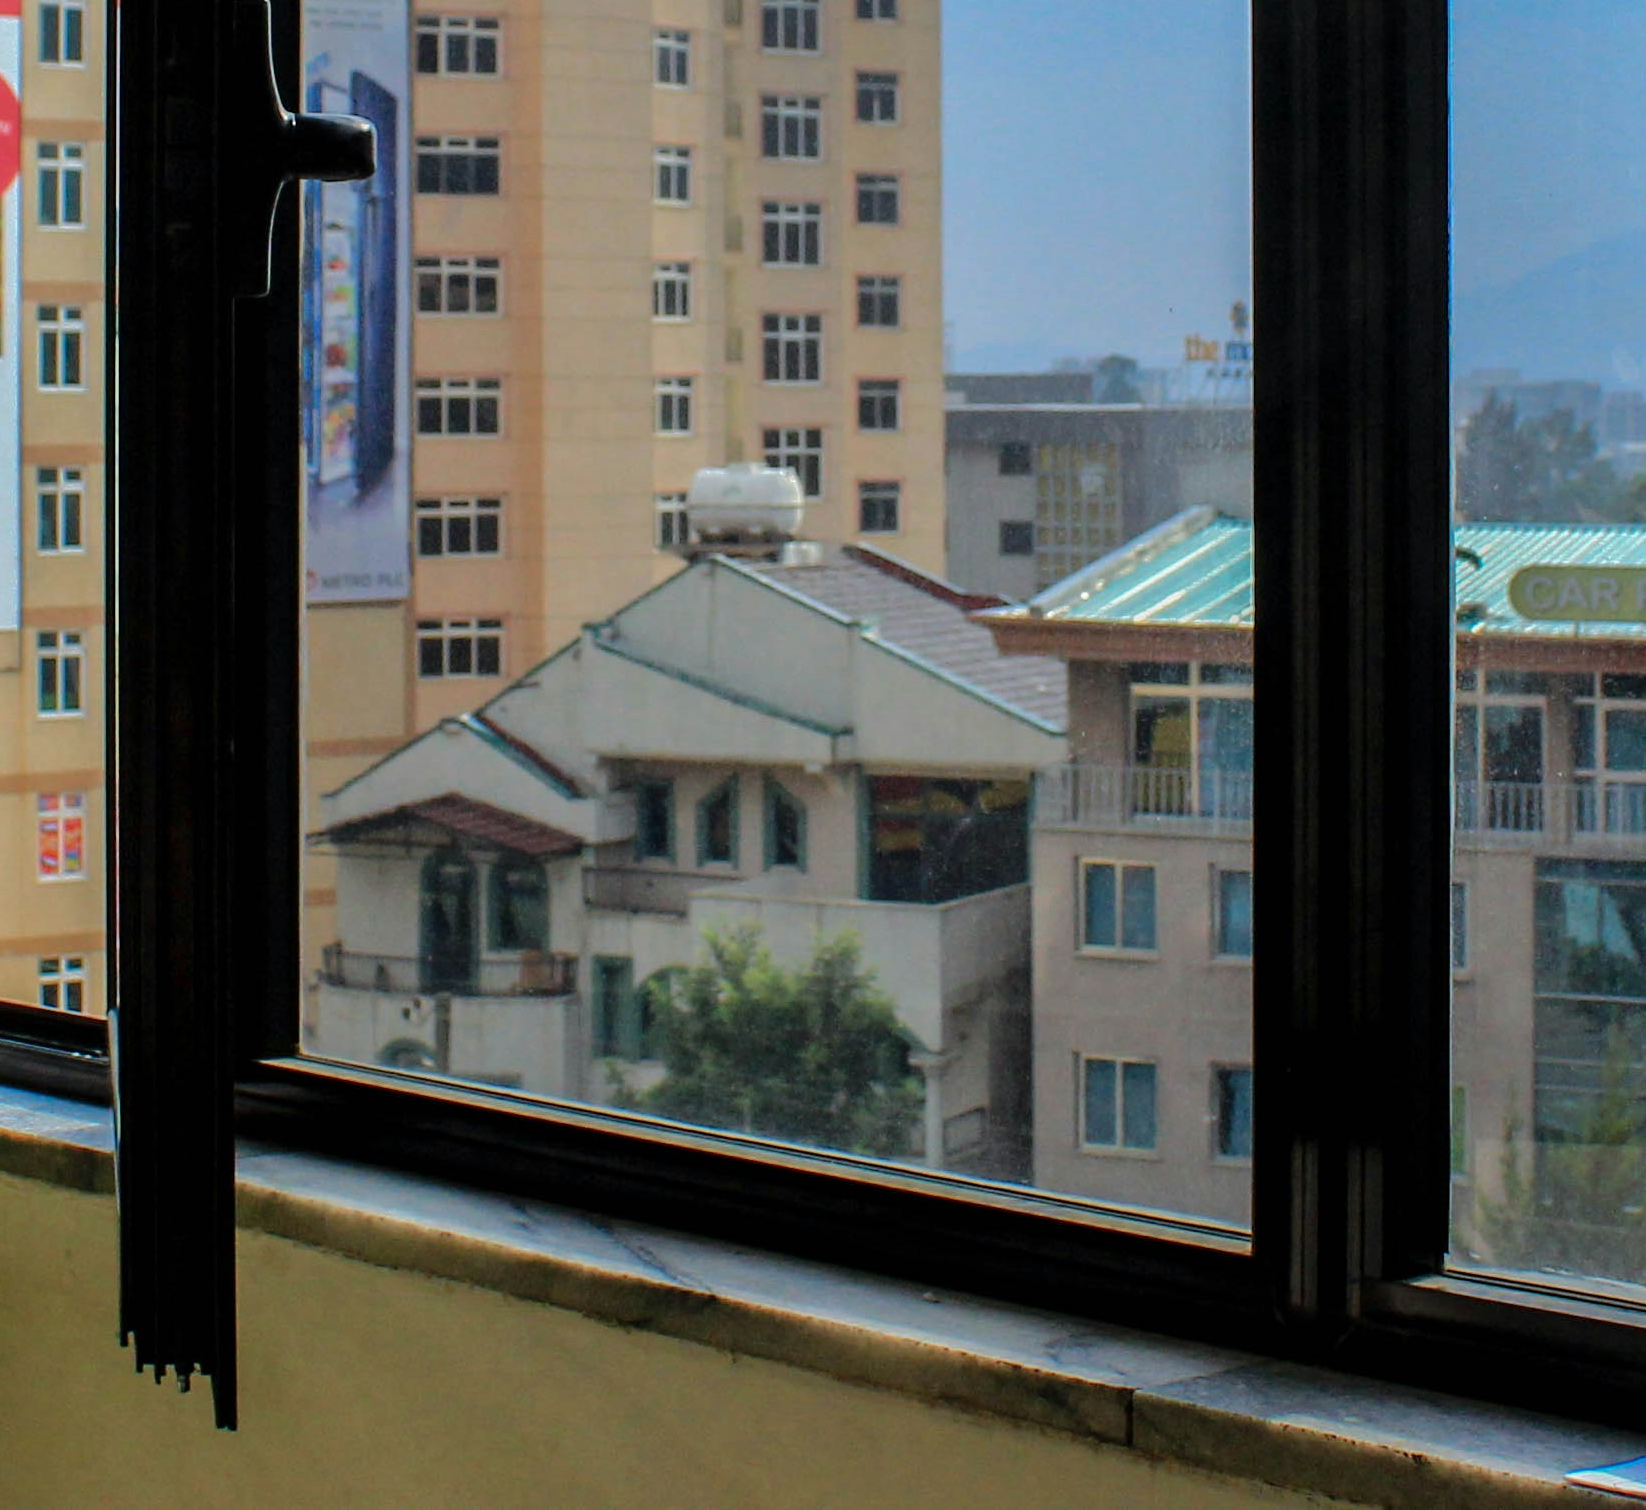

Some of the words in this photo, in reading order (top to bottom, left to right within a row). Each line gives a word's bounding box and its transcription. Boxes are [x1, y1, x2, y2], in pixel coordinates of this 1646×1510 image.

[320, 572, 371, 590] METRO
[376, 571, 405, 588] PLC
[1524, 576, 1622, 613] CAR
